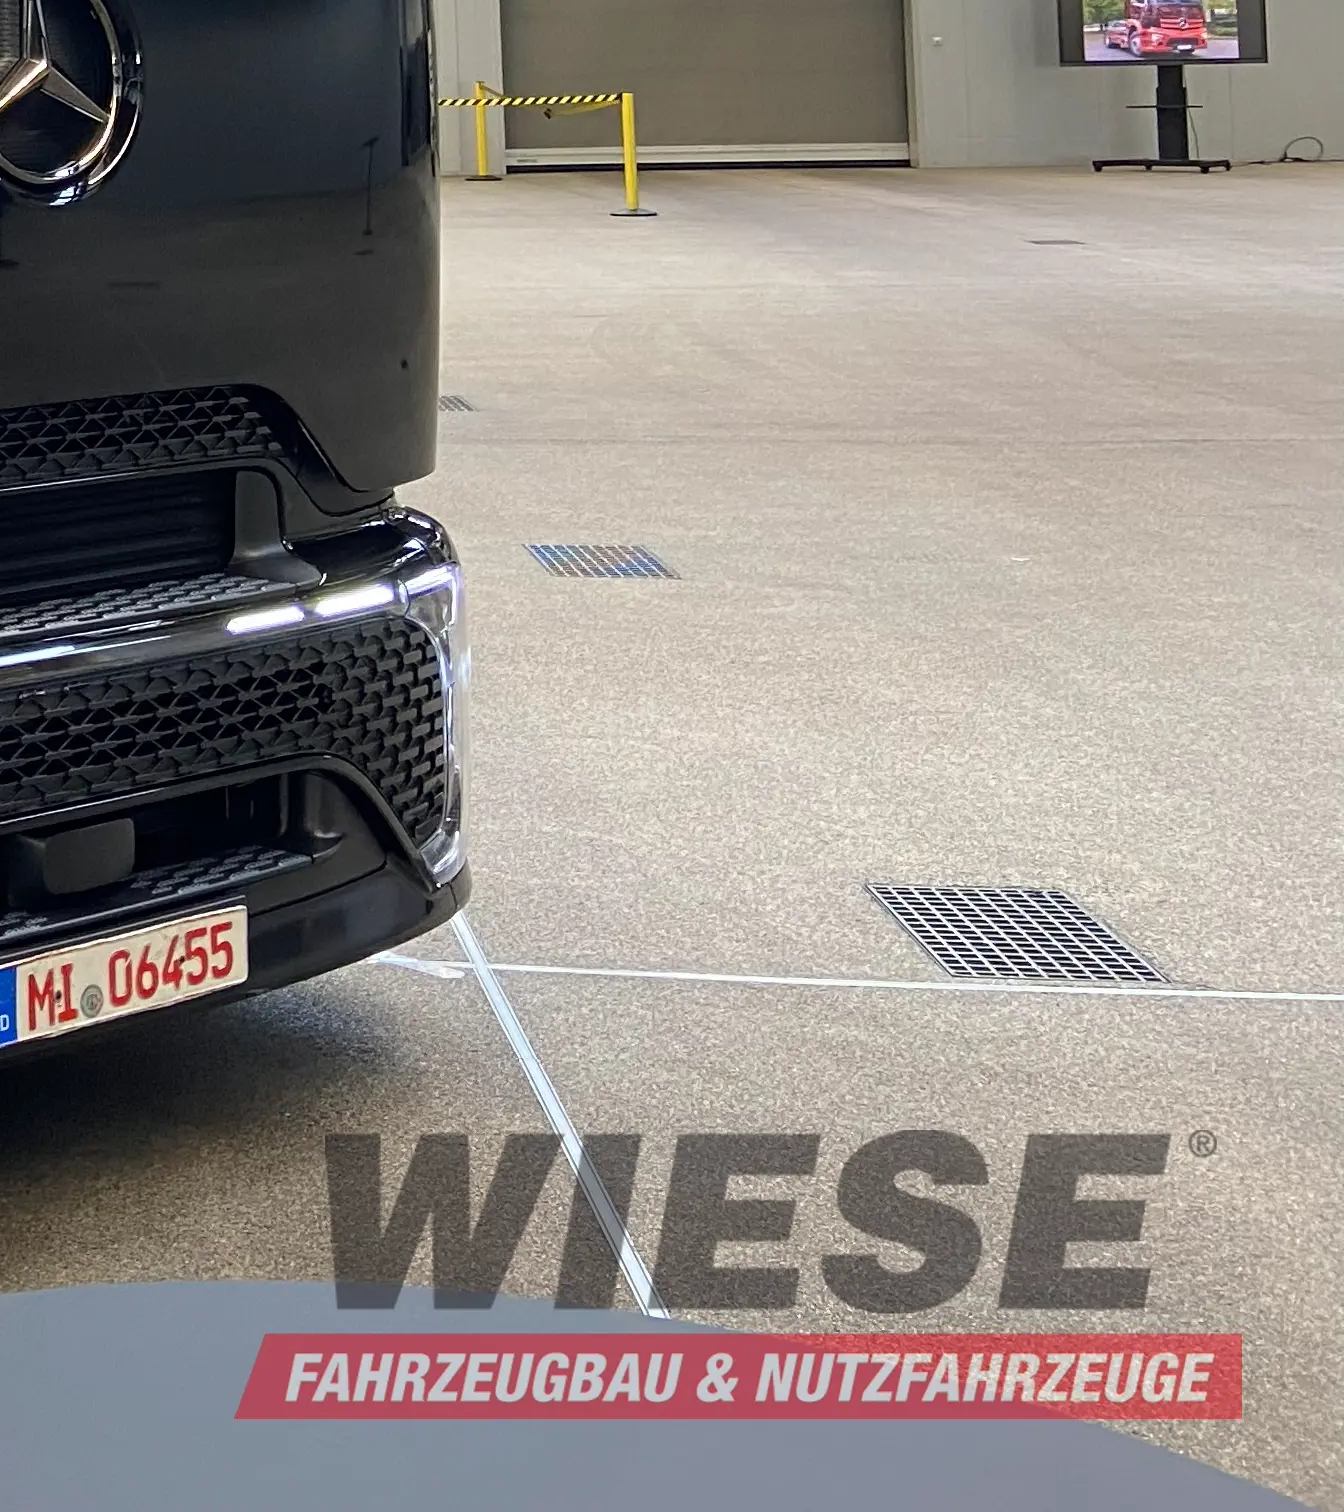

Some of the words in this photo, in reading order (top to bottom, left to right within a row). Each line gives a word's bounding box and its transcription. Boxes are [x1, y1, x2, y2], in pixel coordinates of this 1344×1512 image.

[27, 962, 79, 1031] MI
[108, 920, 234, 1008] 06455
[0, 1013, 10, 1032] D
